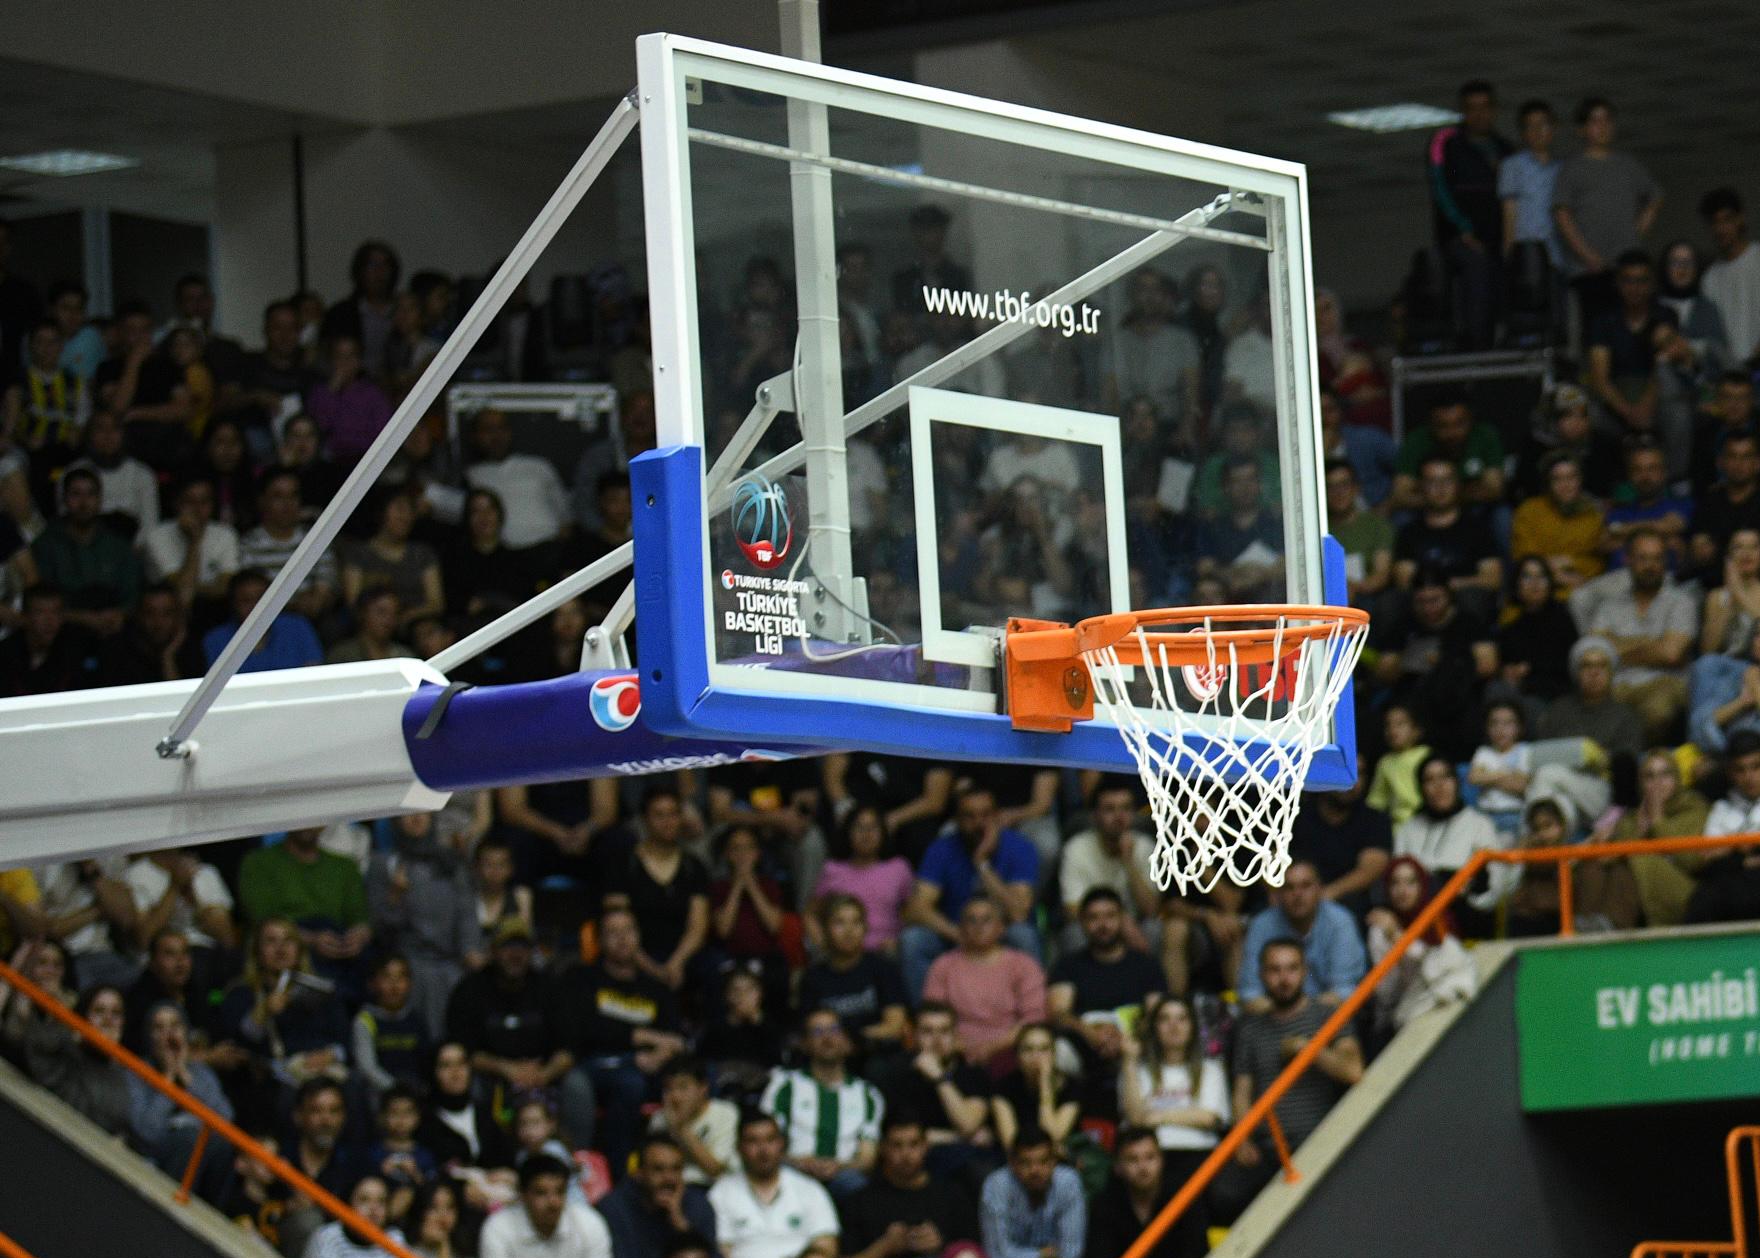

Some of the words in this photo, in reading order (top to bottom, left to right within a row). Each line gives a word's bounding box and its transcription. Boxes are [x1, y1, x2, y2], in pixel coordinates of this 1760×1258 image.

[922, 284, 1102, 338] www.tbf.org.tr
[736, 590, 799, 617] TÜRKİYE
[724, 611, 812, 638] BASKETBOL
[755, 634, 784, 656] LİGİ
[1596, 985, 1641, 1029] EV
[1647, 966, 1759, 1026] SAHİBİ
